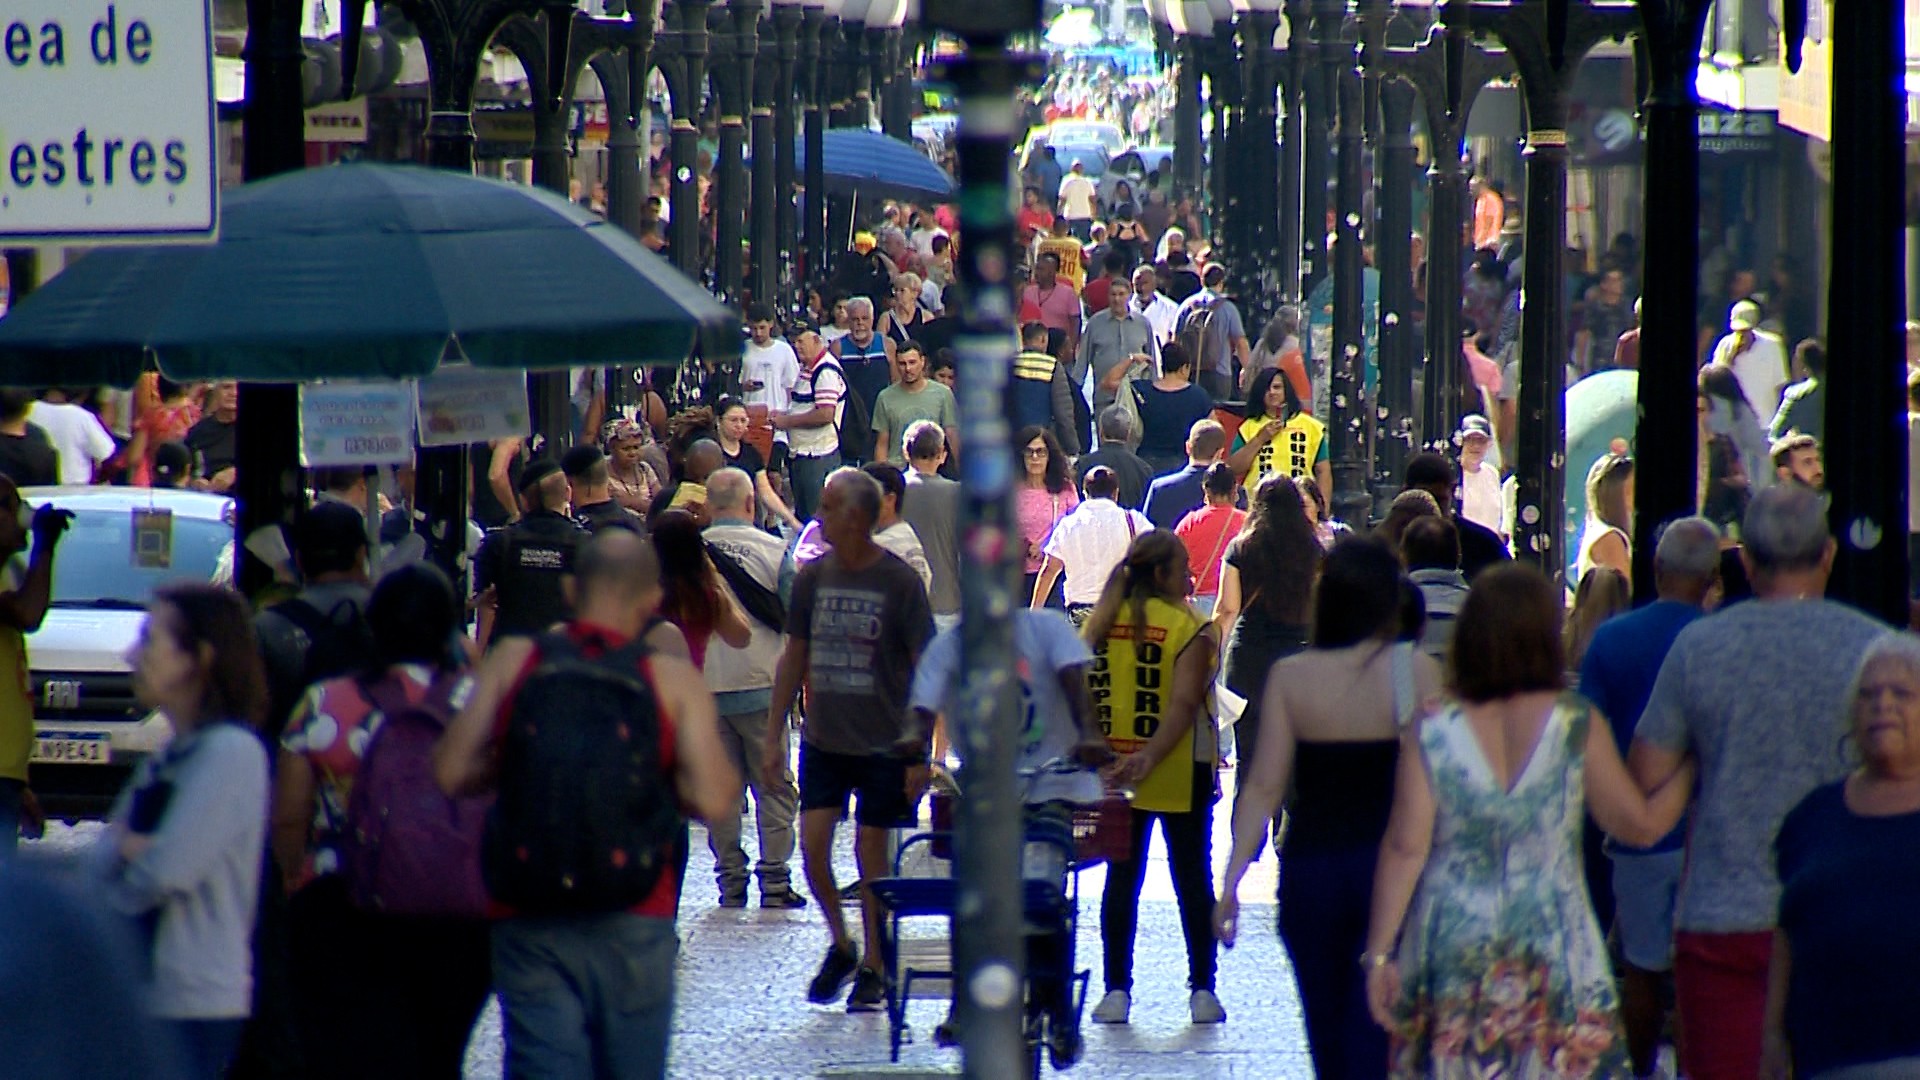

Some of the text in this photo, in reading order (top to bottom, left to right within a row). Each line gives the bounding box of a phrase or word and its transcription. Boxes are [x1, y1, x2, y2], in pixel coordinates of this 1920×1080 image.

[4, 3, 152, 67] ea de
[9, 126, 187, 188] estres
[44, 681, 81, 708] FIAT
[1134, 642, 1163, 738] OURO
